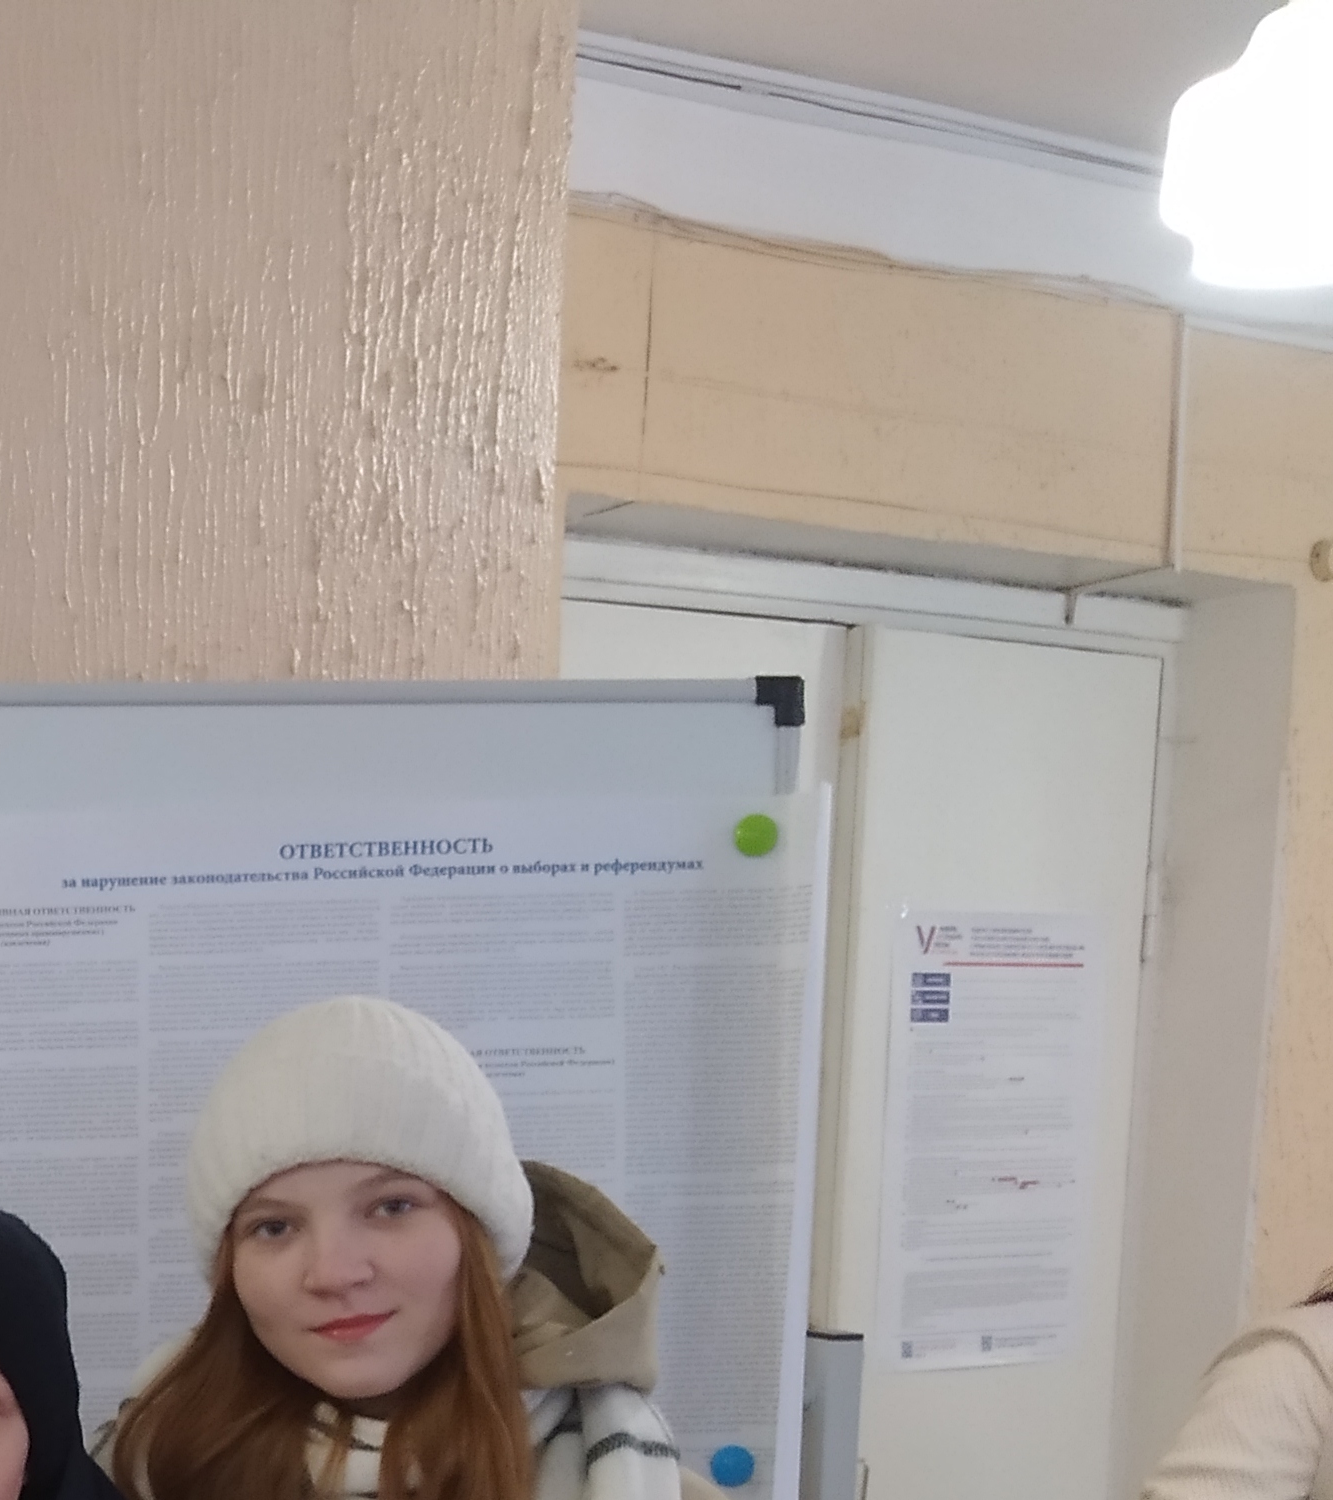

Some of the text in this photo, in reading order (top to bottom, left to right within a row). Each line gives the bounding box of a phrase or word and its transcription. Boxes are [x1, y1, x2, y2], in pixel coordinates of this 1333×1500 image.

[278, 837, 494, 860] ОТВЕТСТВЕННОСТЬ
[61, 857, 704, 891] за нарушение законодательства Российской Федерации о выборах и референдумах
